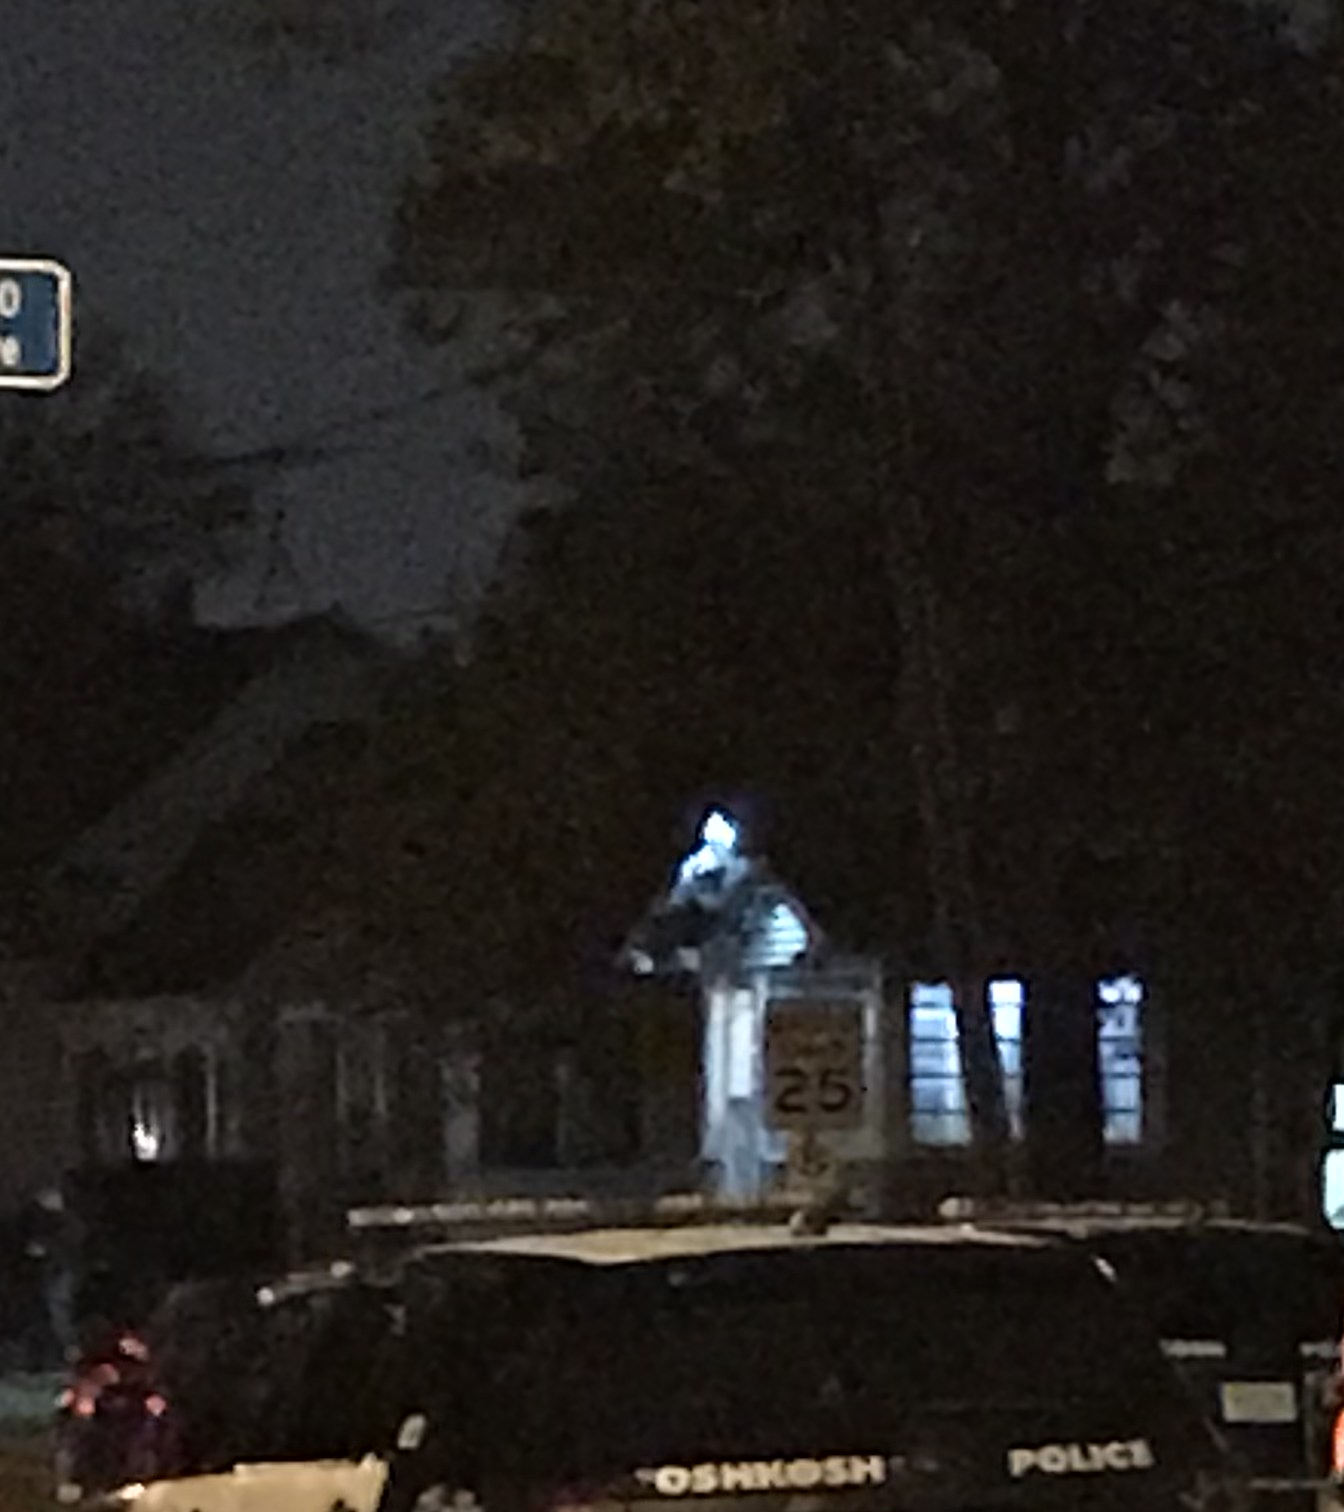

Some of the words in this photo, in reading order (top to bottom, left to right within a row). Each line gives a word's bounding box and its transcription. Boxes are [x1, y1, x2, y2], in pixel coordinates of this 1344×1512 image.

[774, 1066, 853, 1114] 25
[655, 1455, 886, 1495] OSHKOSH
[1007, 1438, 1154, 1477] POLICE
